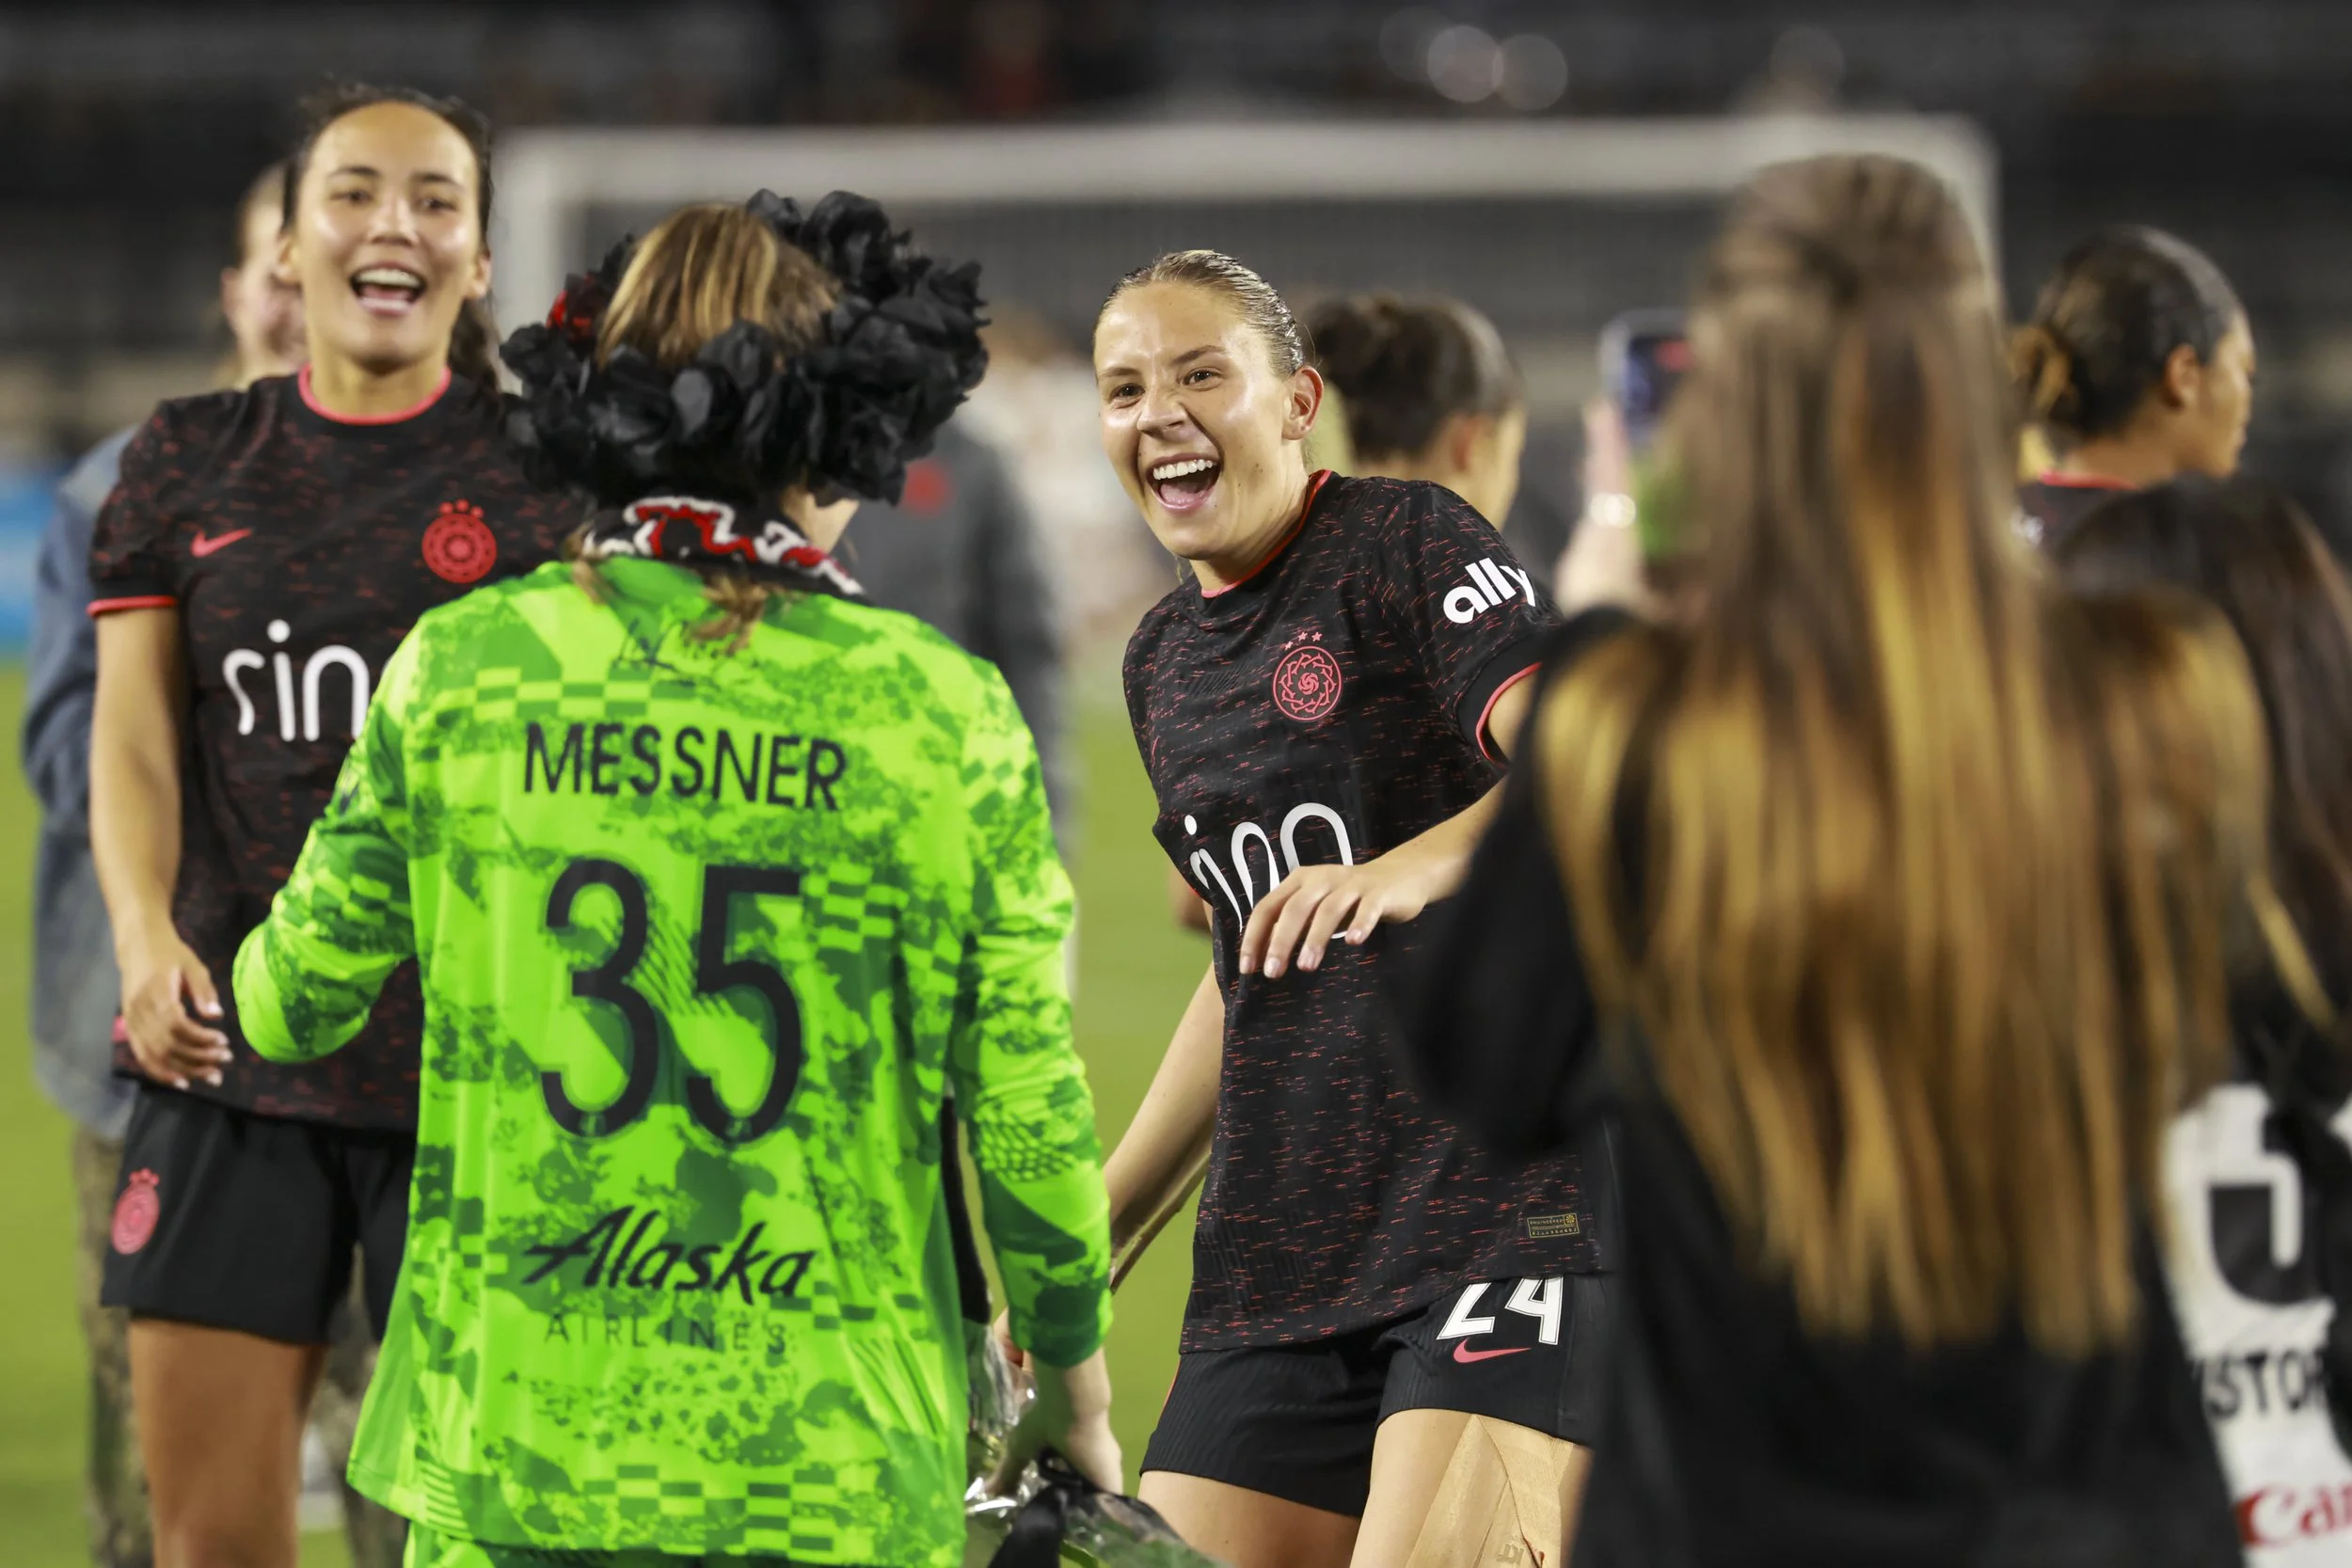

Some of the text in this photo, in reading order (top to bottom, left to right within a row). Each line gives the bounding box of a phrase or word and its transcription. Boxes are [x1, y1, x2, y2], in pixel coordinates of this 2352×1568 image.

[1443, 557, 1535, 624] ally
[223, 619, 386, 741] rin
[524, 721, 846, 811] MESSNER
[540, 859, 803, 1145] 35
[521, 1205, 816, 1306] Alaska
[544, 1314, 787, 1354] AIRLINES
[1436, 1275, 1564, 1345] 24
